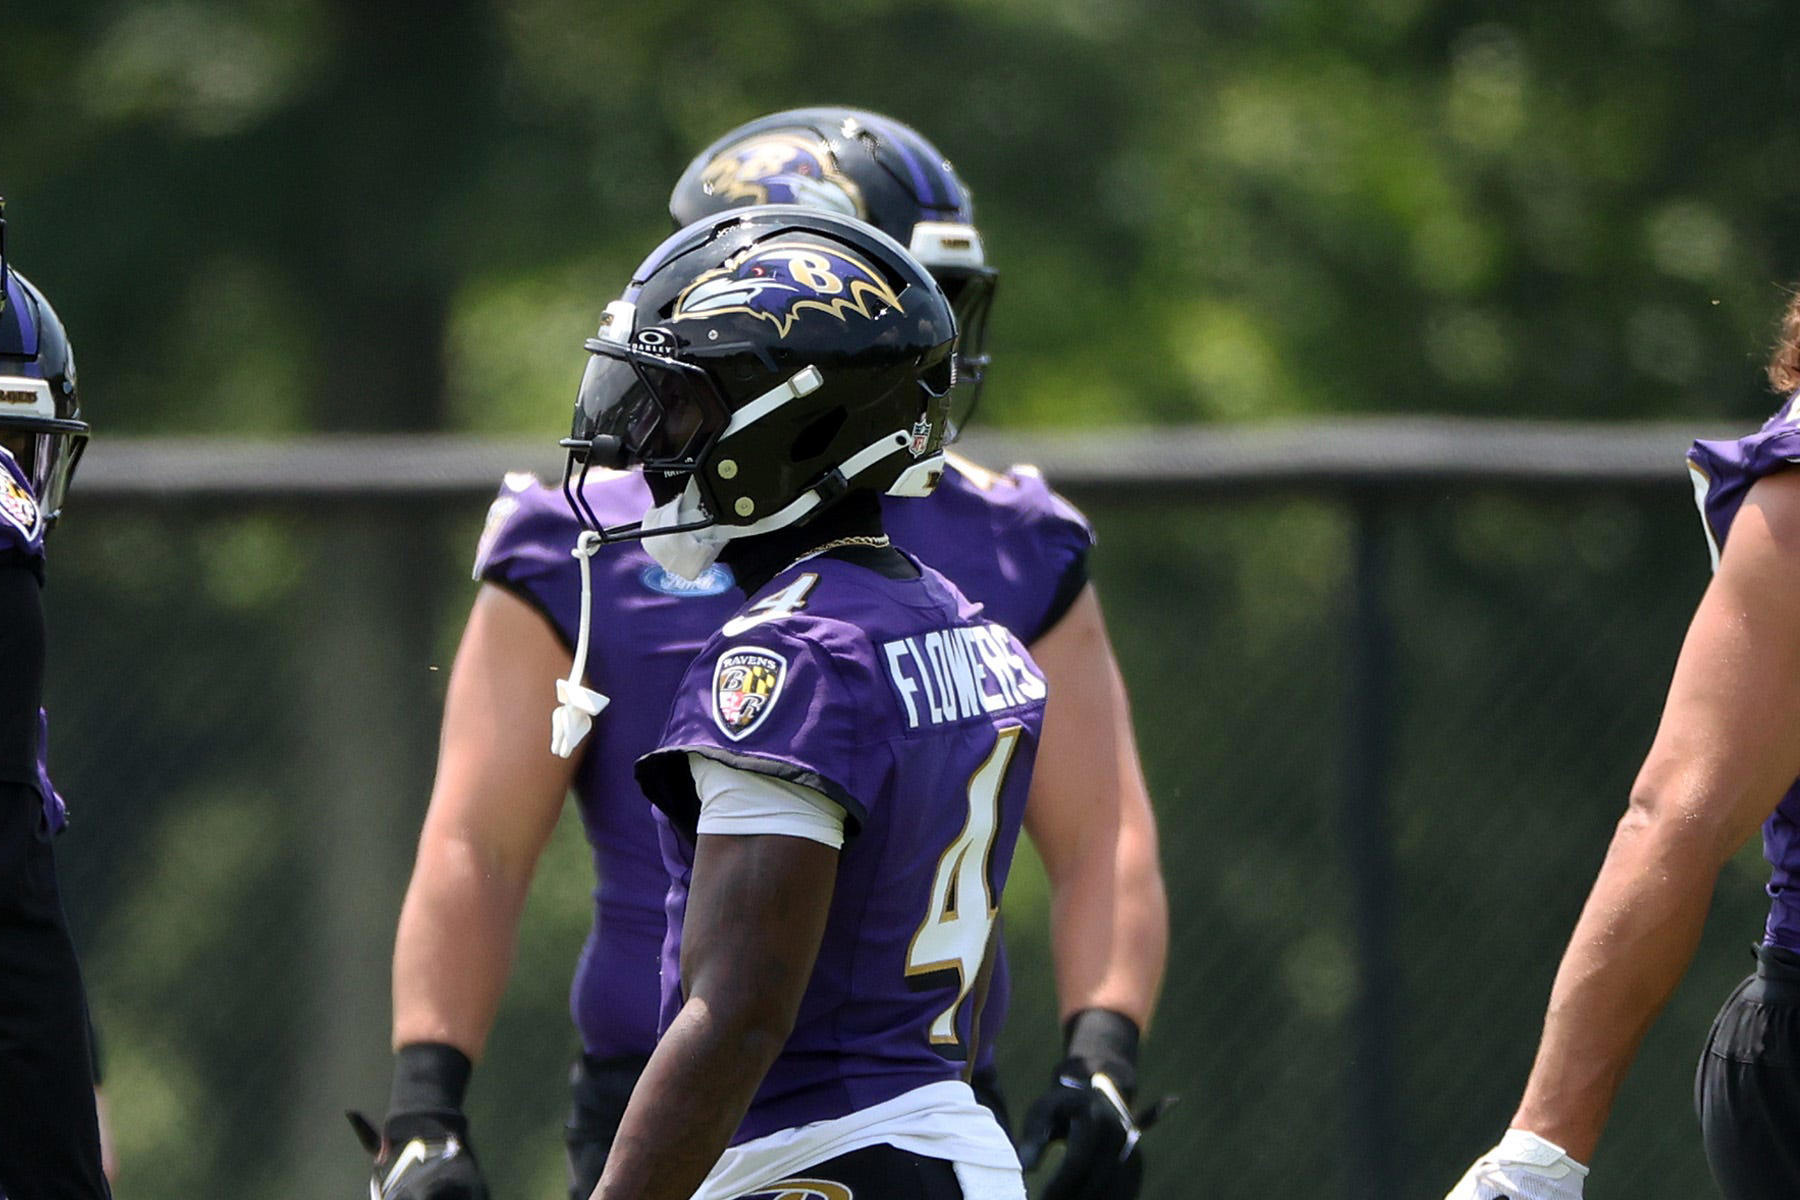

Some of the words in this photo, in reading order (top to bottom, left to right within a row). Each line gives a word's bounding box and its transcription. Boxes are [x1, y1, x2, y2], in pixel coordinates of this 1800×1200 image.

[756, 250, 843, 294] B
[631, 343, 671, 354] OAKLEY
[723, 656, 777, 669] RAVENS
[883, 624, 1047, 728] FLOWERS
[904, 725, 1021, 1045] 4
